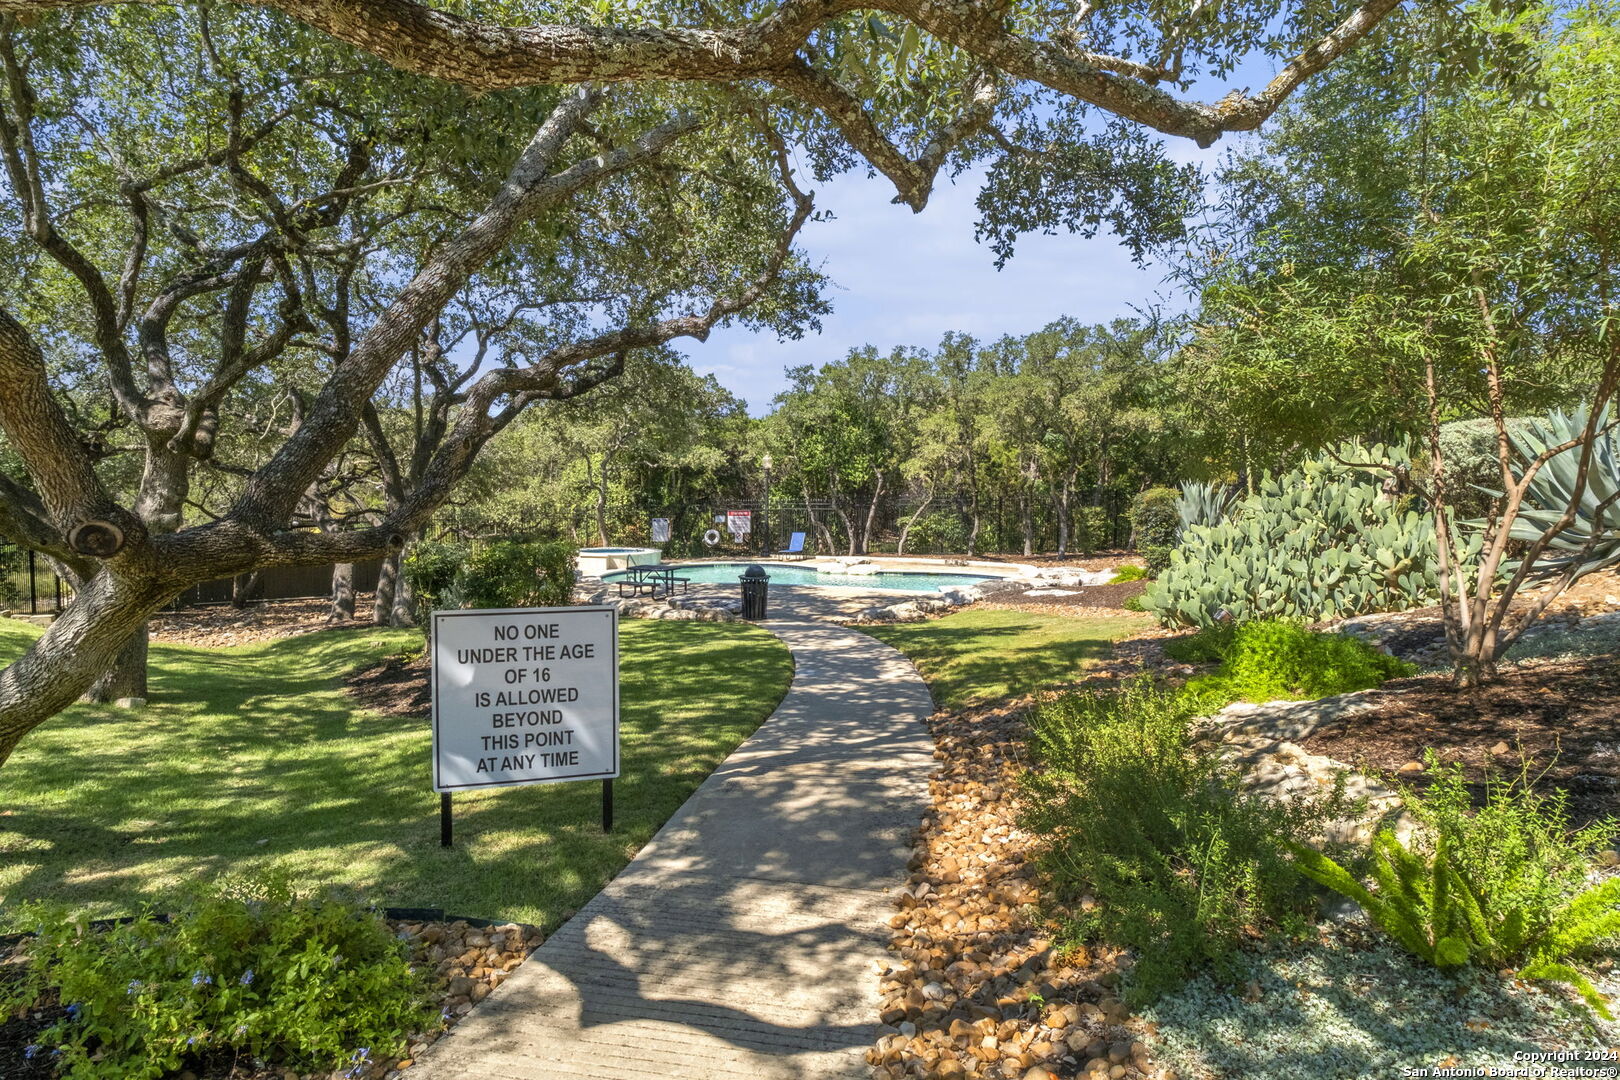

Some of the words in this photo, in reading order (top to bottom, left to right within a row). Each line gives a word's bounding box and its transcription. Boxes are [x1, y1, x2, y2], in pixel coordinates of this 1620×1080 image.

[494, 625, 519, 641] NO
[524, 623, 560, 639] ONE
[457, 648, 518, 664] UNDER
[523, 645, 555, 662] THE
[559, 643, 595, 660] AGE
[504, 668, 527, 684] OF
[533, 667, 551, 683] 16
[475, 692, 491, 708] IS
[495, 687, 579, 706] ALLOWED
[493, 709, 563, 729] BEYOND
[481, 733, 519, 751] THIS
[524, 730, 574, 748] POINT
[476, 757, 498, 773] AT
[501, 754, 536, 772] ANY
[540, 750, 579, 768] TIME
